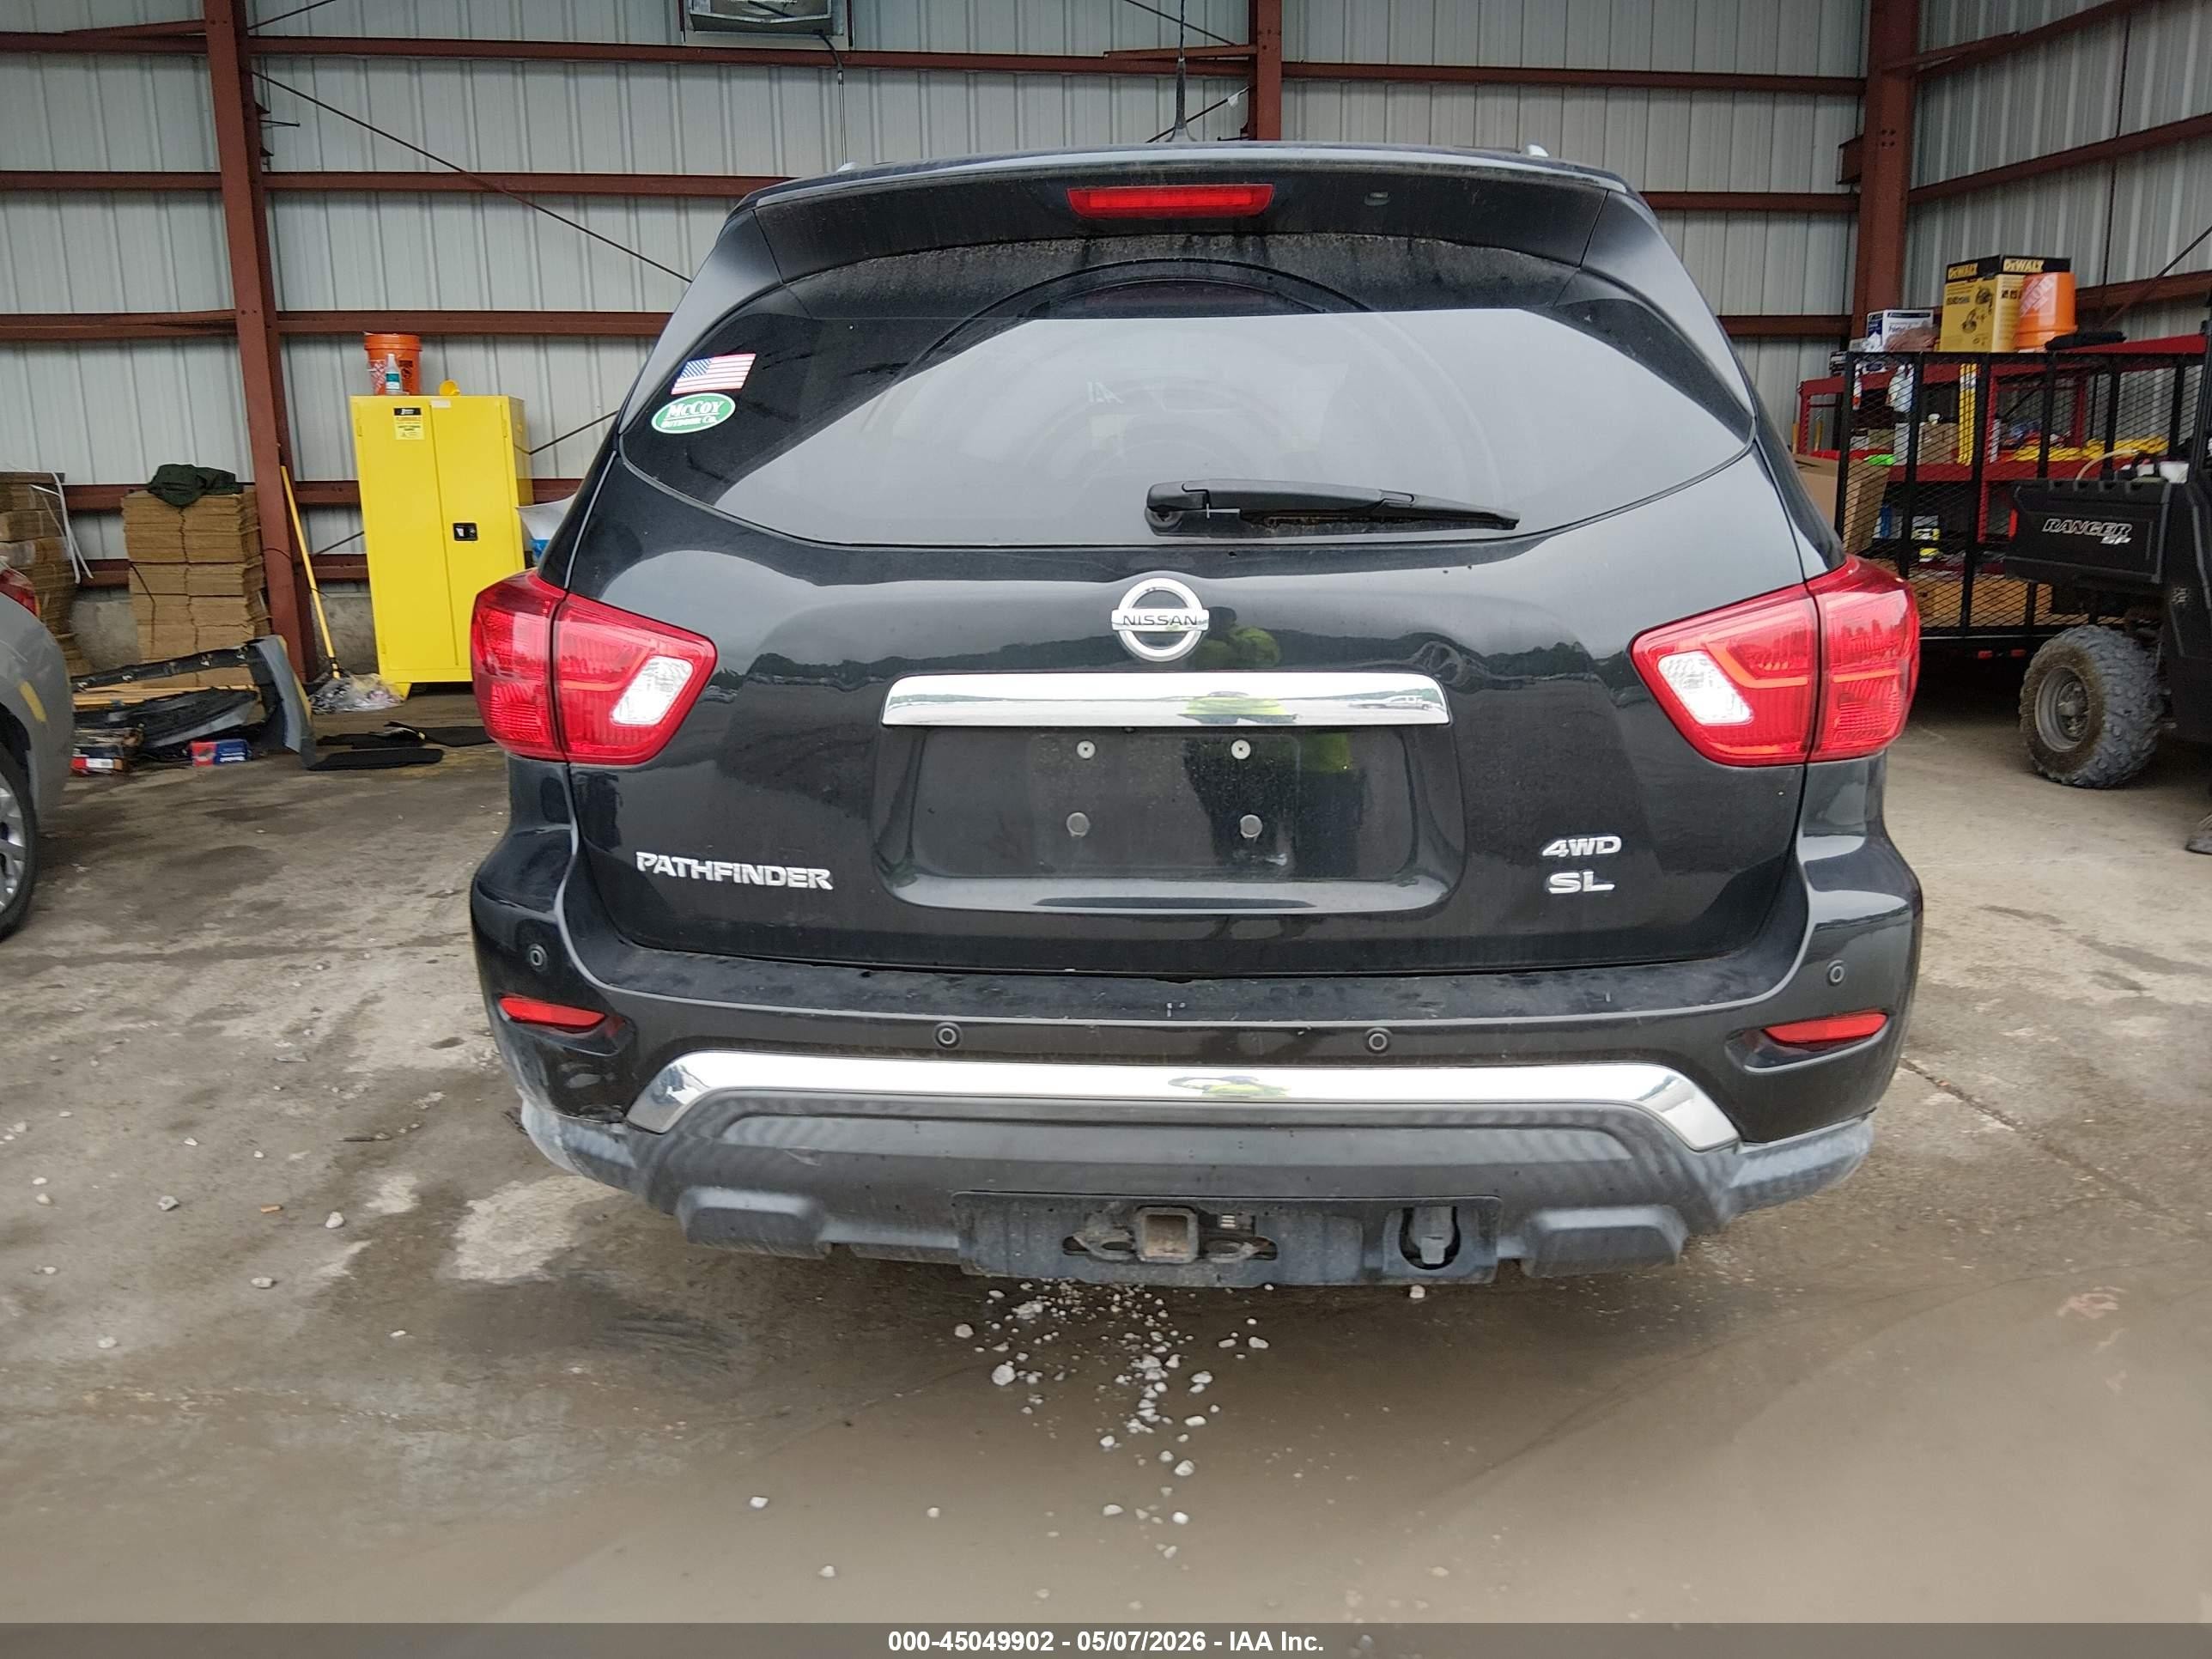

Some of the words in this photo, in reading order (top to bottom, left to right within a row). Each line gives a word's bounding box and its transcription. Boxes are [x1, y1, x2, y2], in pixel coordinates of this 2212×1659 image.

[2041, 518, 2133, 537] RANGER
[1122, 615, 1198, 626] NISSAN
[1542, 836, 1622, 857] 4WD
[635, 851, 833, 890] PATHFINDER
[1548, 871, 1615, 894] SL
